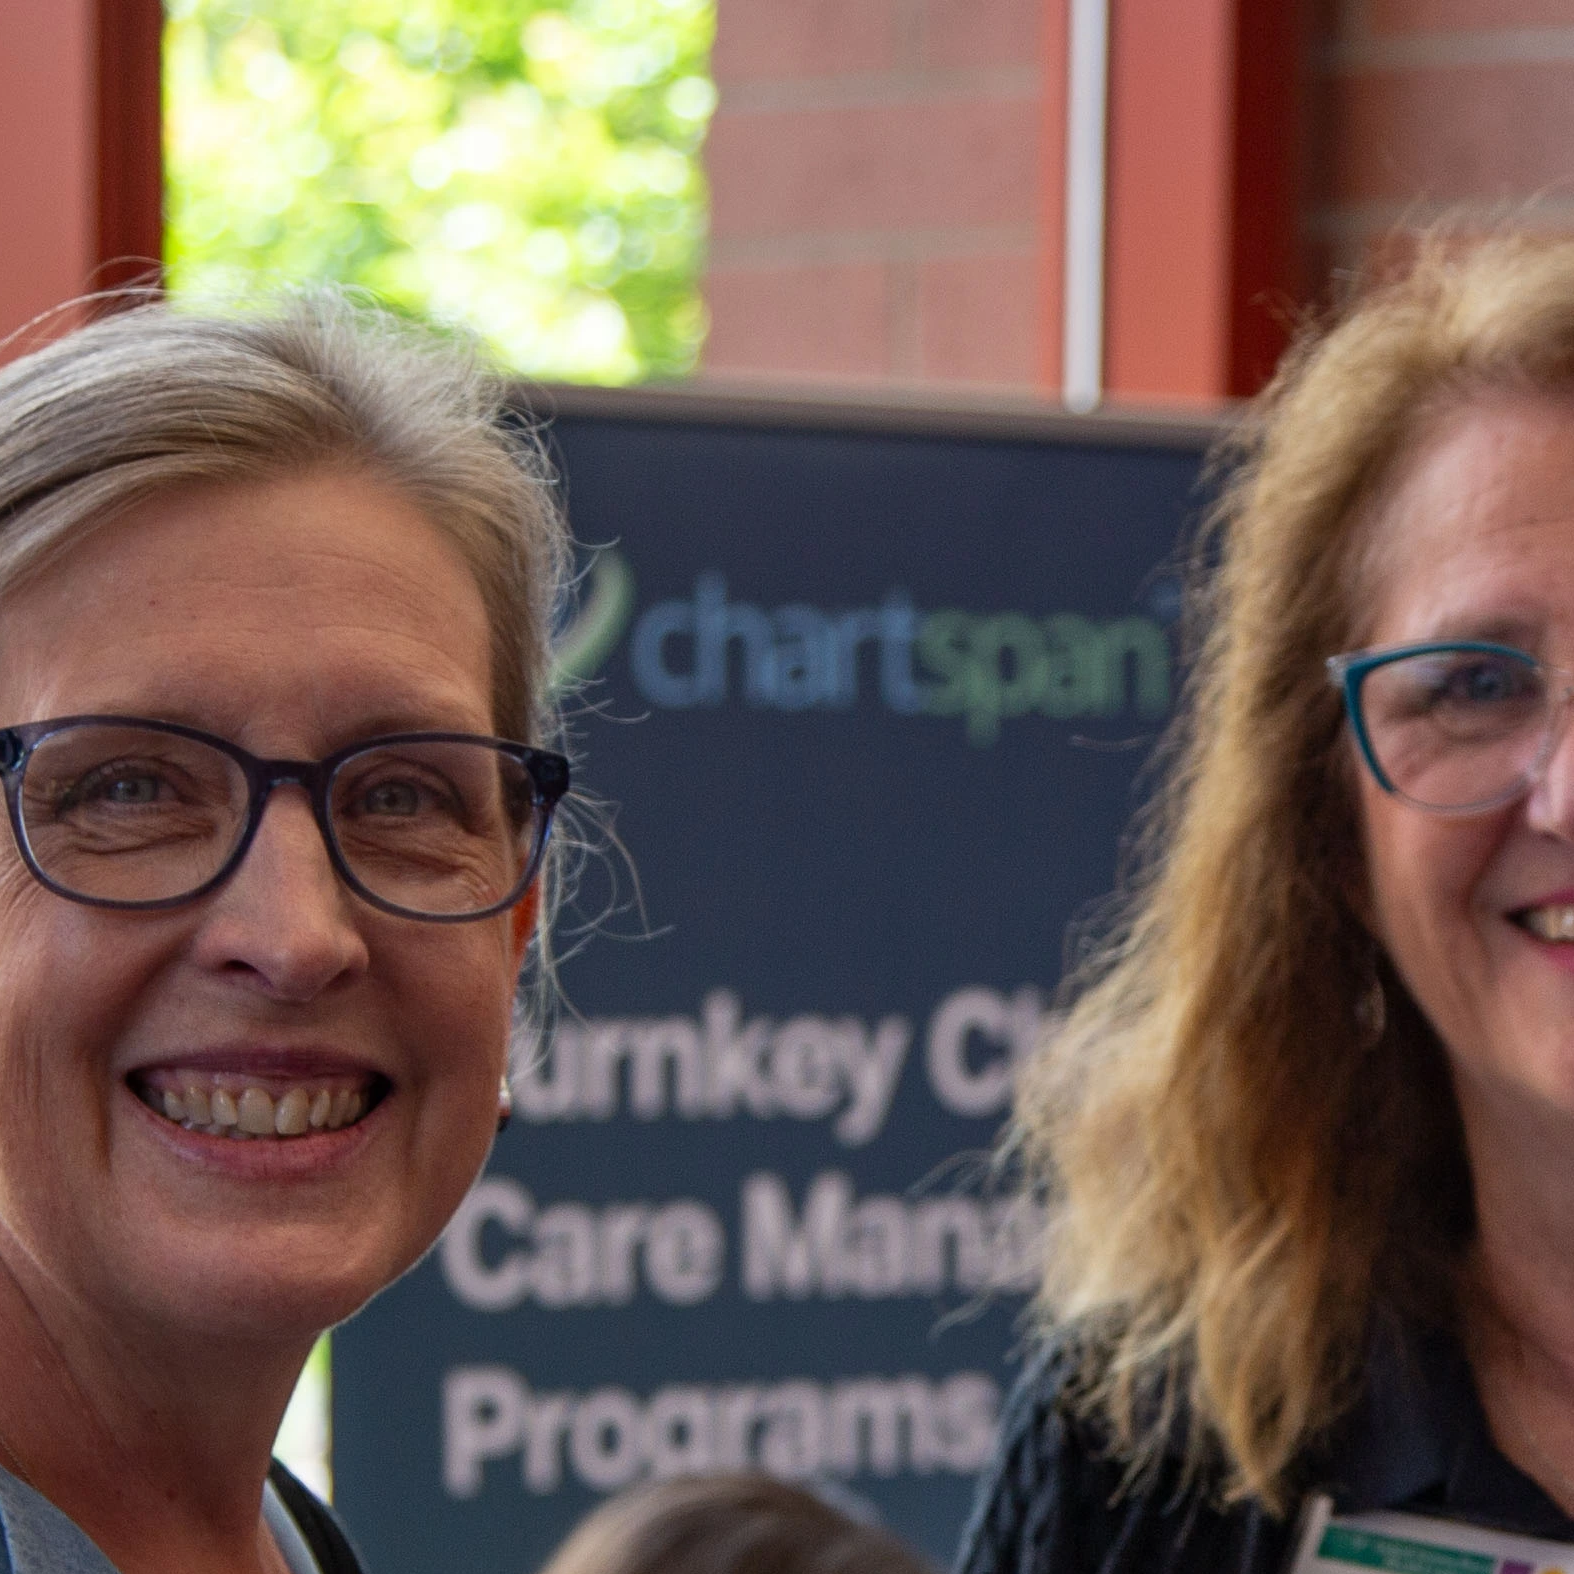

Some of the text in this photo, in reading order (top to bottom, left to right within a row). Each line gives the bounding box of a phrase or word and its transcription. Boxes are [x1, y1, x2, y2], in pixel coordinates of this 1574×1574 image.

[631, 572, 1171, 745] chartspan
[512, 990, 914, 1146] urnkey
[441, 1177, 724, 1308] Care
[439, 1364, 1008, 1496] Programs
